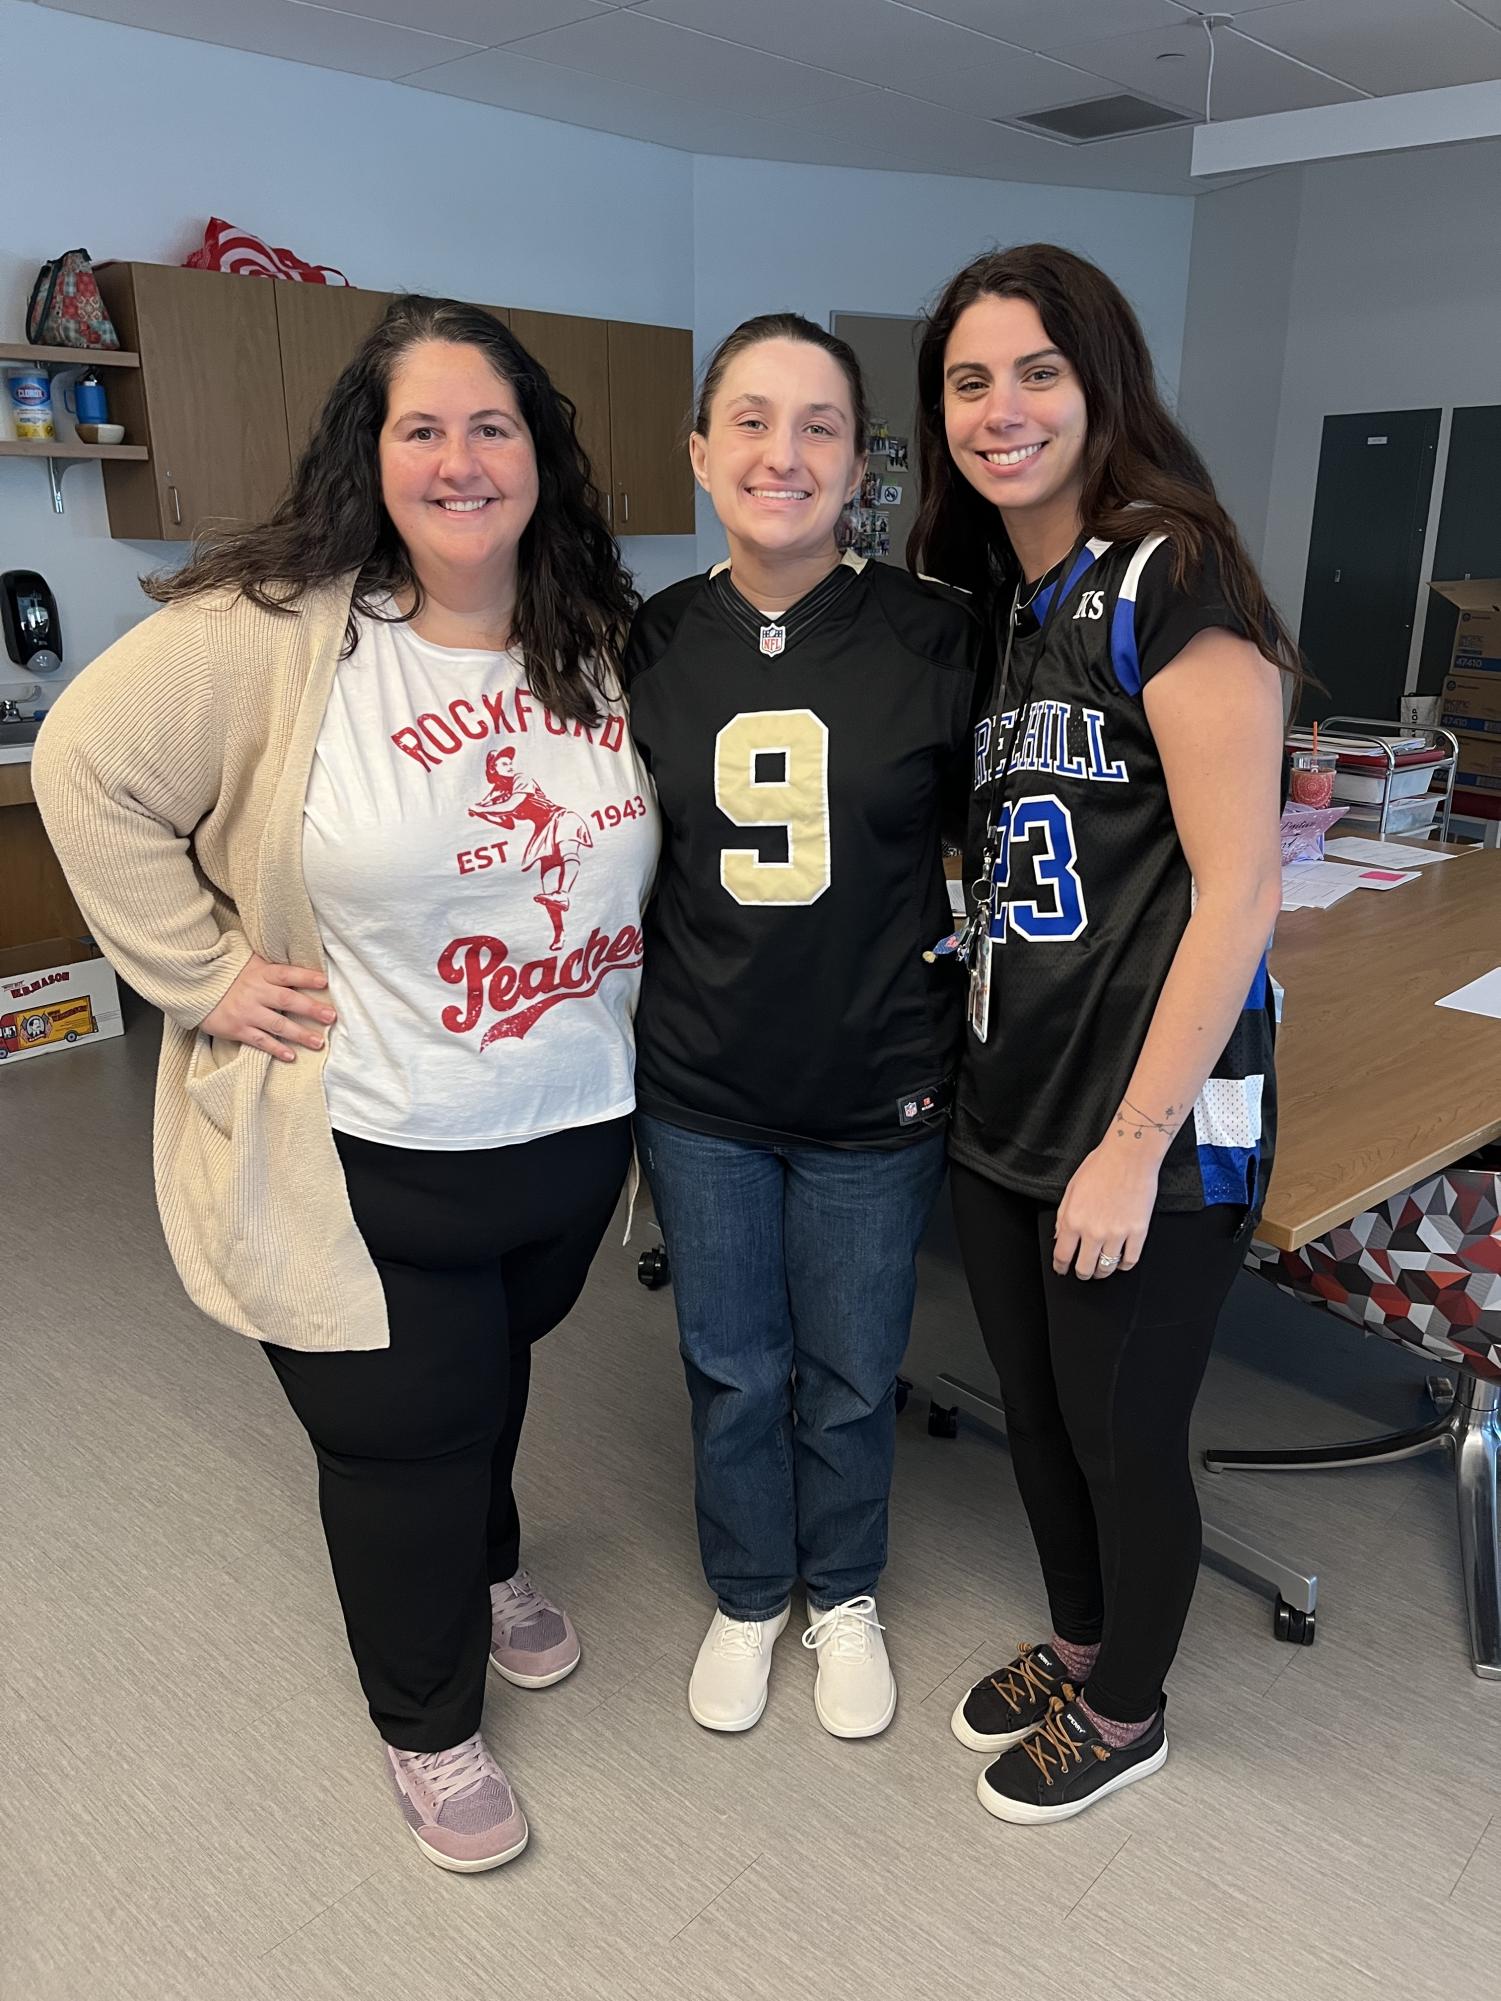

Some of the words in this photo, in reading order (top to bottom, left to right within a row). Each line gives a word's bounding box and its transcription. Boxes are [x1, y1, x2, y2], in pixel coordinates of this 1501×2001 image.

[1072, 591, 1104, 620] KS
[764, 638, 780, 651] NFL
[1456, 657, 1482, 669] 47410
[591, 795, 647, 832] 1943
[714, 708, 831, 906] 9
[456, 841, 509, 875] EST
[988, 793, 1088, 943] 23
